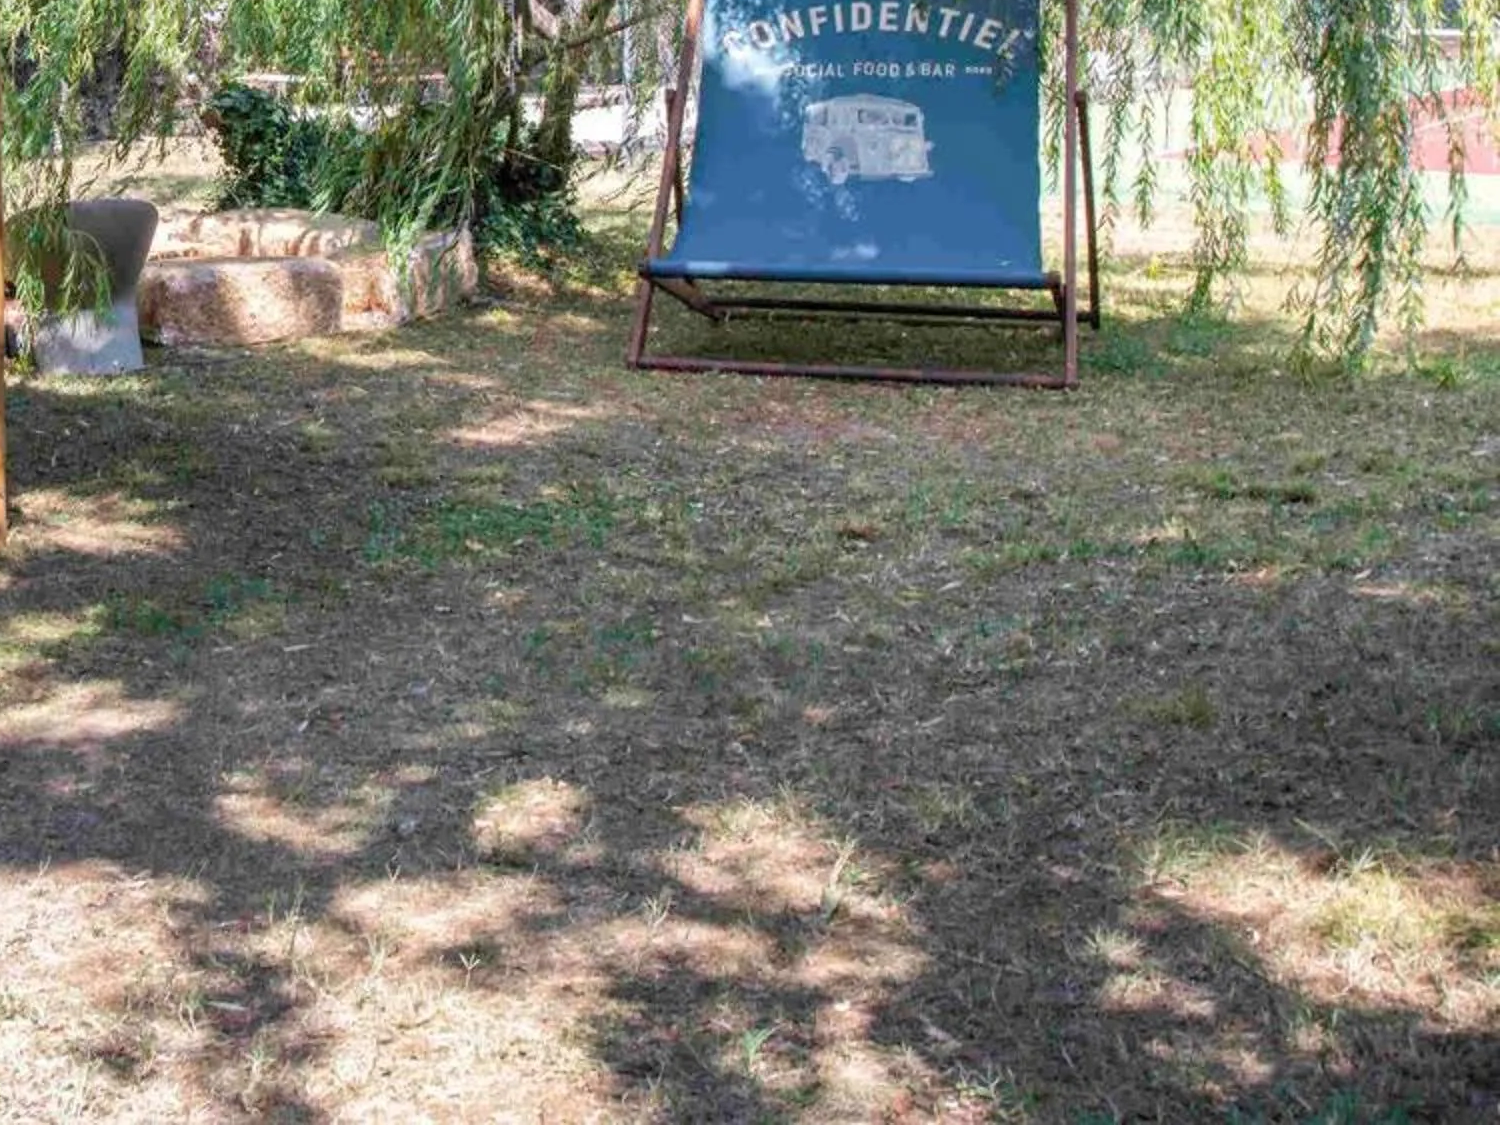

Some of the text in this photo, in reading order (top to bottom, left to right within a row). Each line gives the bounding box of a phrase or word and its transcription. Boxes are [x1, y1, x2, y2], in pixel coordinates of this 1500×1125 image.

[853, 61, 900, 78] FOOD
[905, 62, 916, 78] &
[921, 62, 956, 78] BAR
